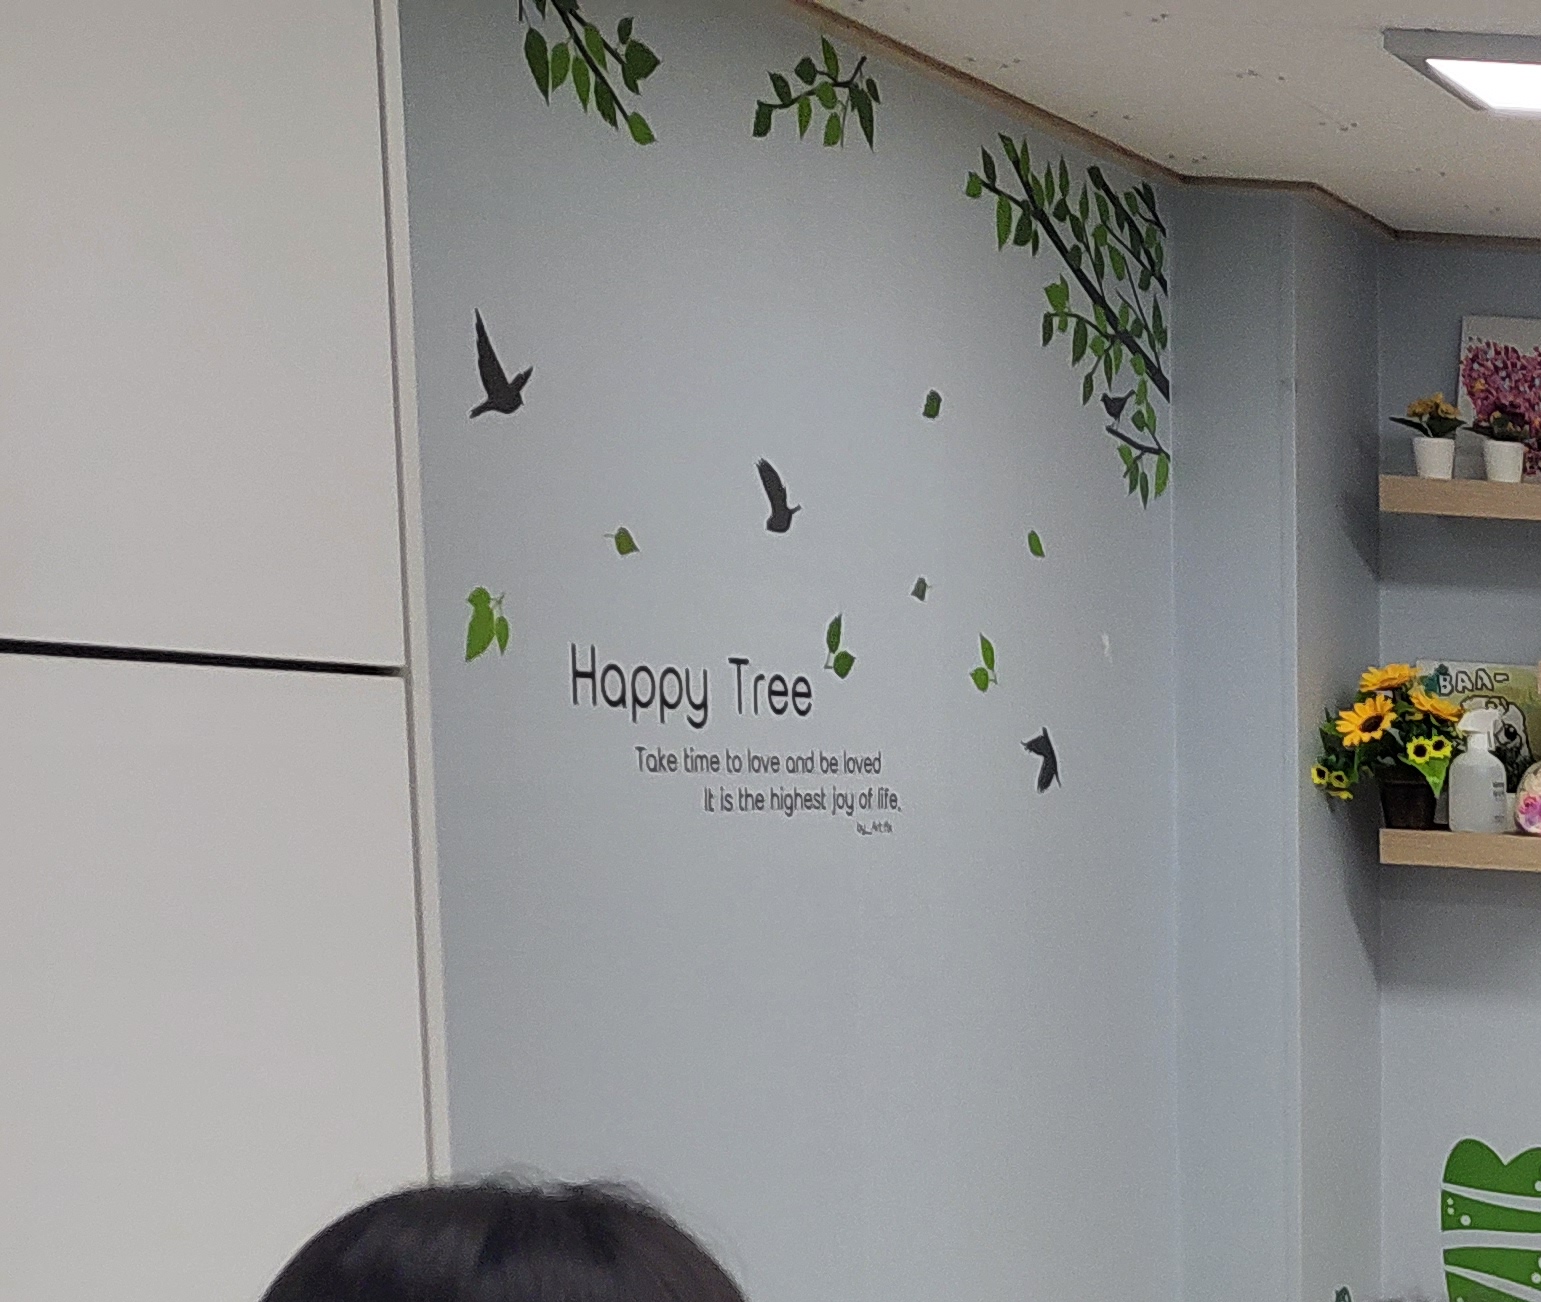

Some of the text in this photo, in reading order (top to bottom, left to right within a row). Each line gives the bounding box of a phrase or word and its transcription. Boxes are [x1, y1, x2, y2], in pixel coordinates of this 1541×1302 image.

[570, 641, 813, 730] Happy Tree
[1437, 667, 1510, 697] BAA-
[634, 746, 882, 775] Take time to love and be loved
[704, 785, 903, 817] It is the highest joy of life.
